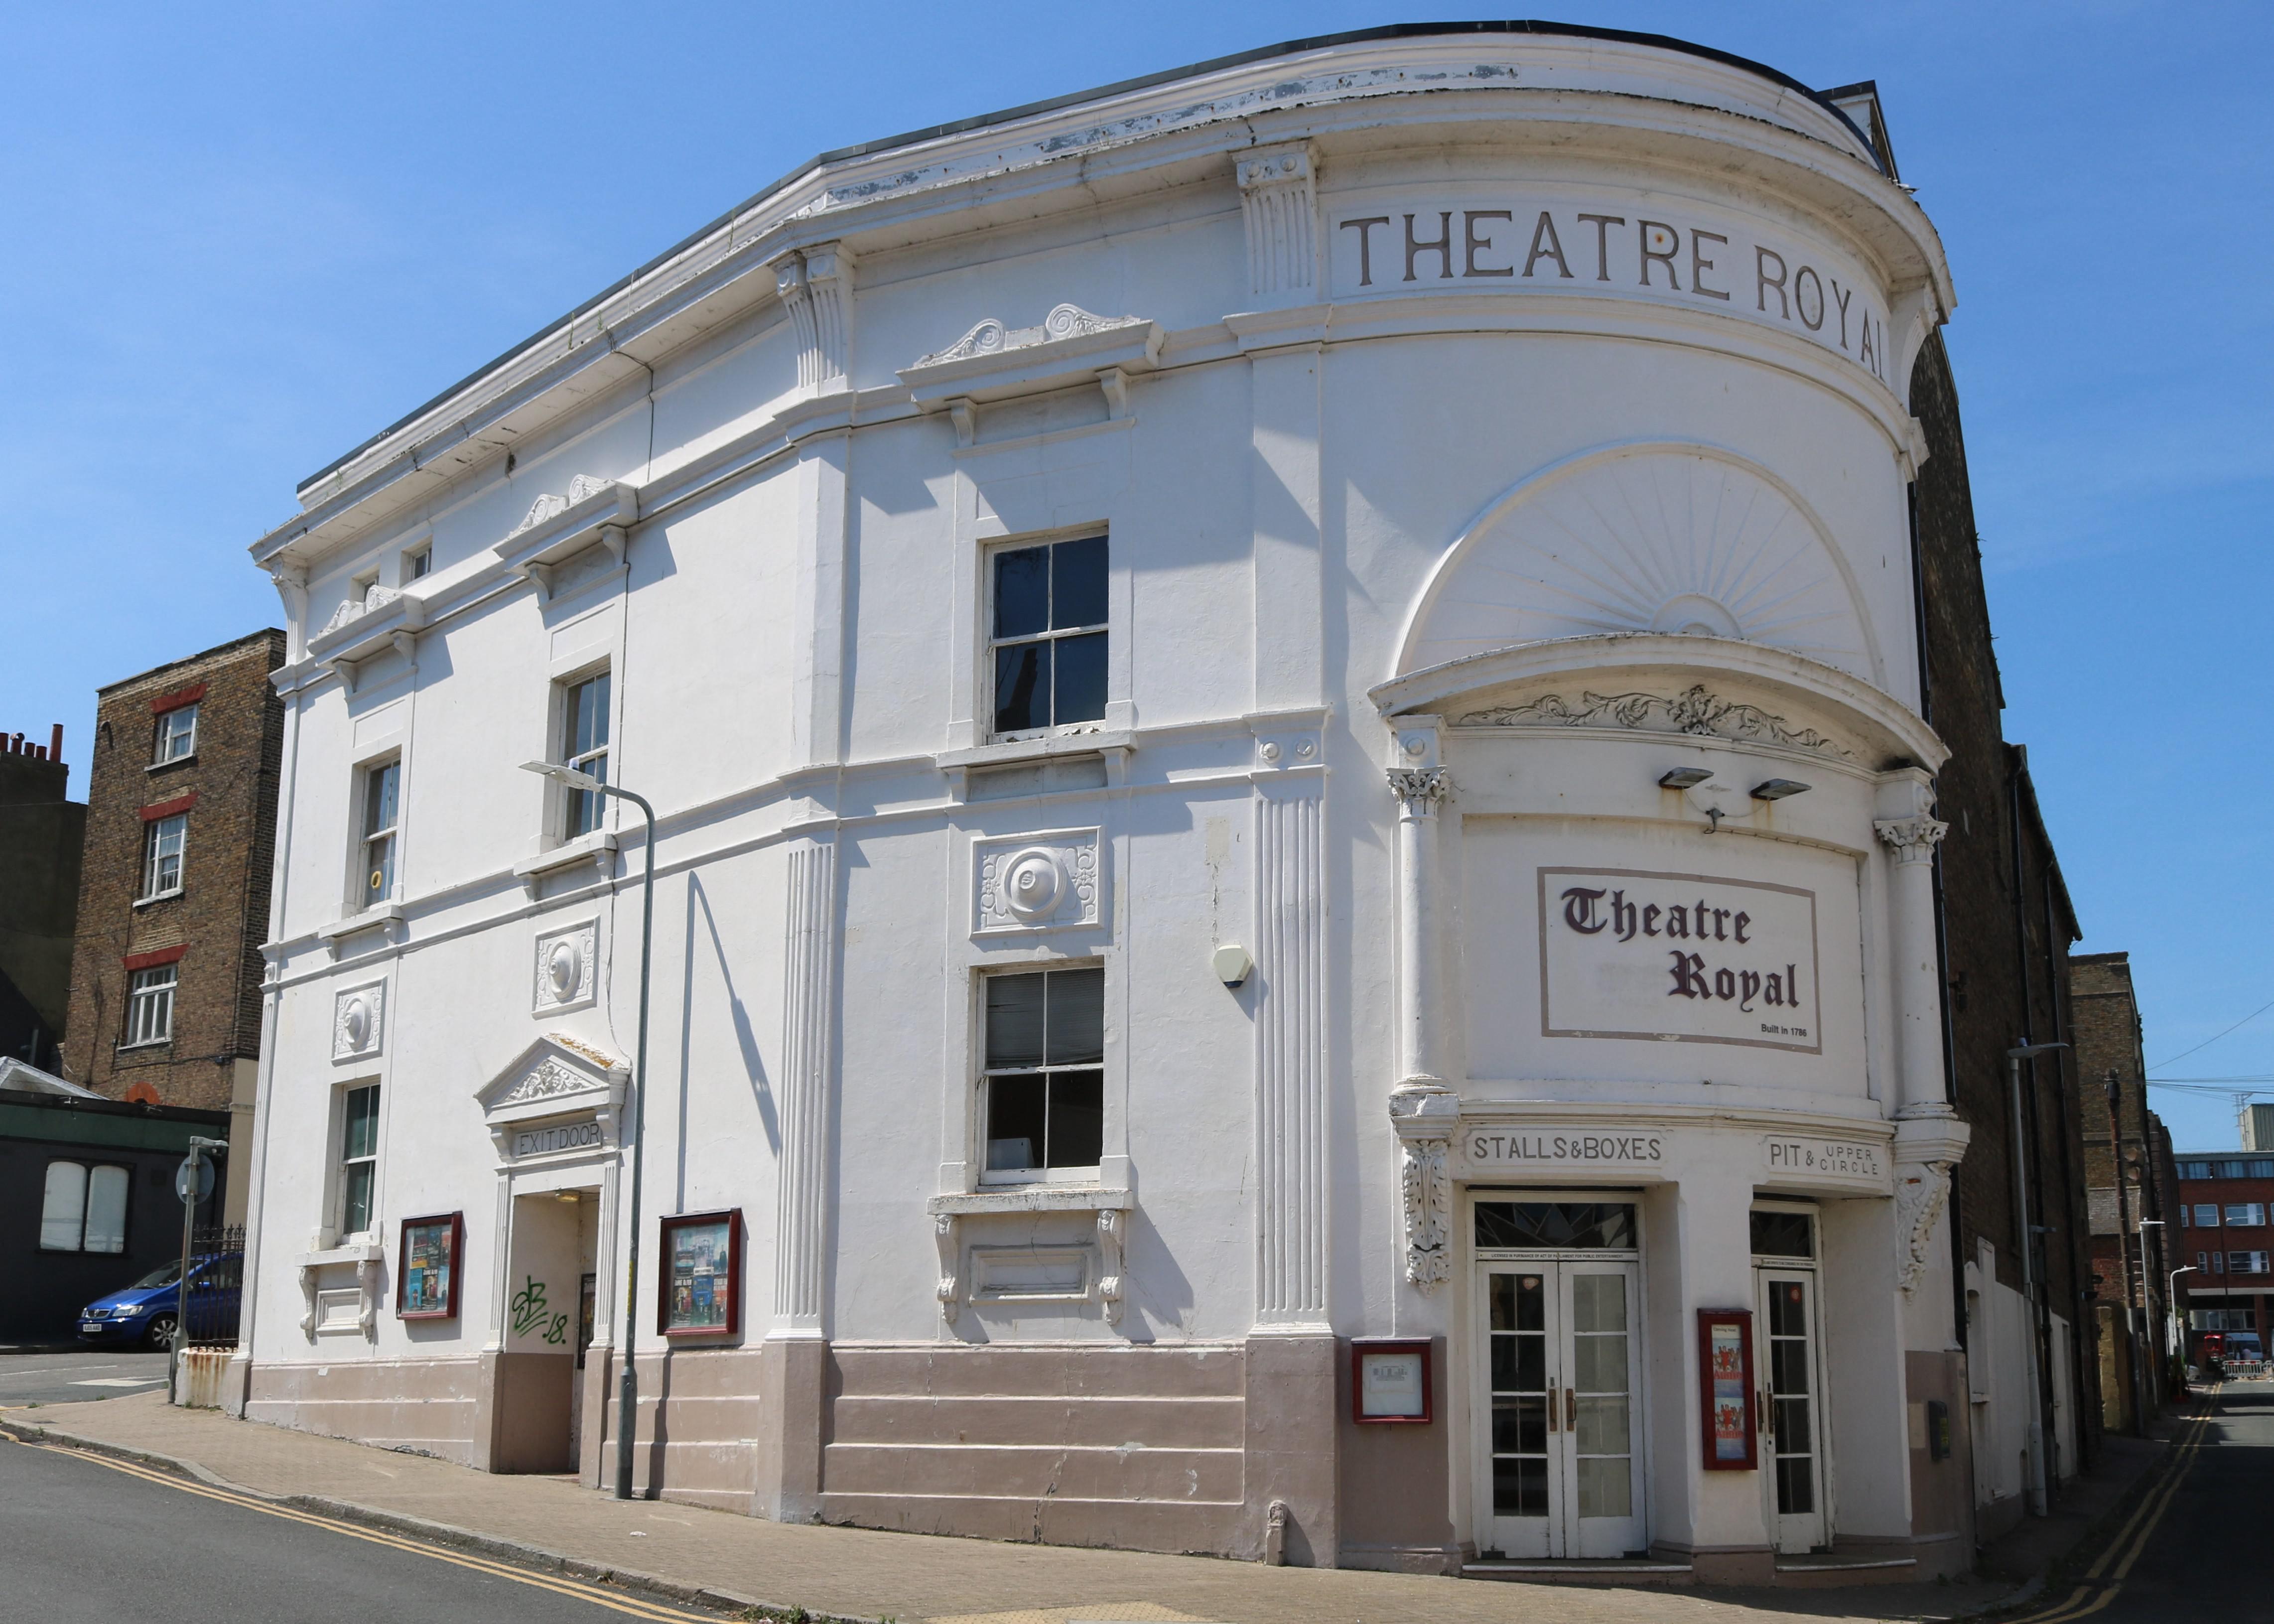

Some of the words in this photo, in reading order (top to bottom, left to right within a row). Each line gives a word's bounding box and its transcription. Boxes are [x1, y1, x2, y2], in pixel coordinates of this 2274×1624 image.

[1339, 210, 1730, 301] THEATRE
[1753, 244, 1886, 383] ROYAL
[1561, 887, 1751, 944] Theatre
[1669, 950, 1800, 1013] Royal
[1761, 1023, 1779, 1034] Built
[1781, 1026, 1788, 1035] in
[1790, 1027, 1807, 1037] 1786
[520, 1130, 555, 1155] EXIT
[558, 1123, 599, 1149] DOOR
[1770, 1143, 1801, 1166] PIT
[1805, 1150, 1814, 1166] &
[1820, 1159, 1878, 1175] CIRCLE
[1826, 1146, 1873, 1161] UPPER
